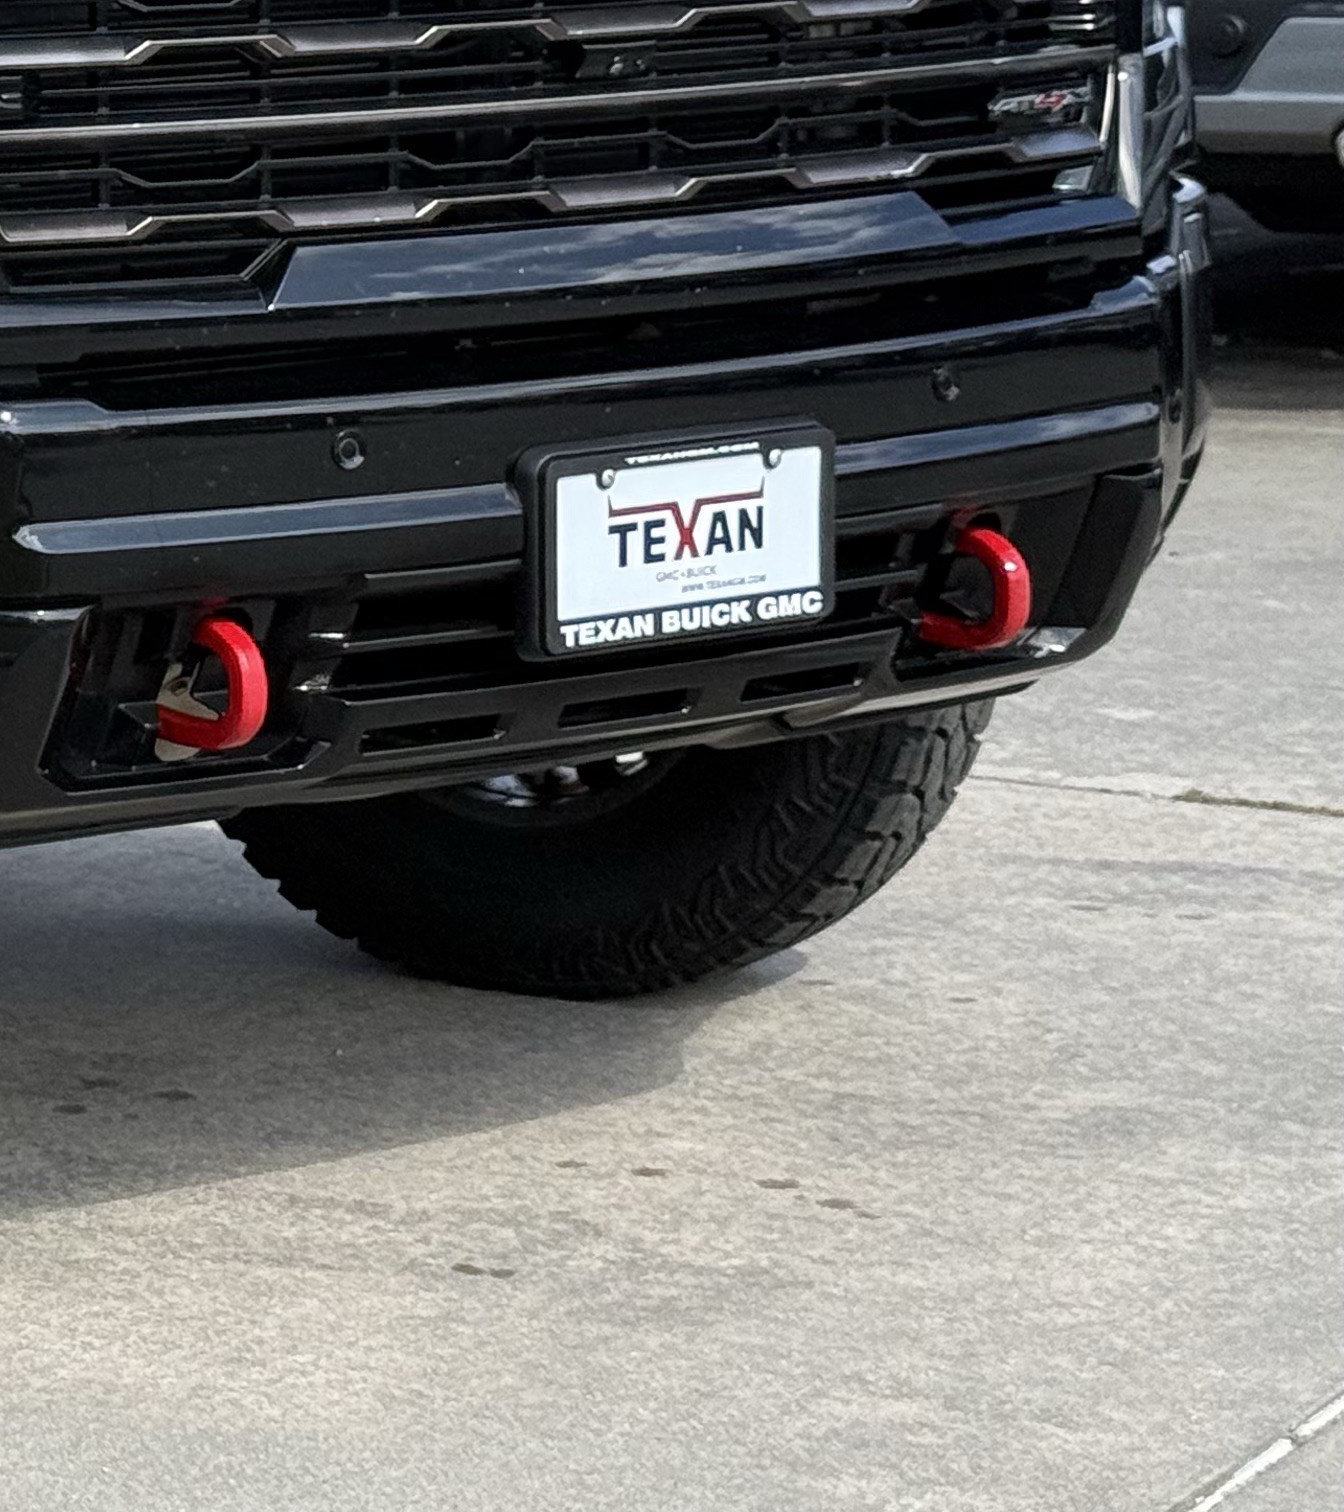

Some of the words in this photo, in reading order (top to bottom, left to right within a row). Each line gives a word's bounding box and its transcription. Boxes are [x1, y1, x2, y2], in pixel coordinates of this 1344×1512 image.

[608, 501, 764, 568] TEXAN
[560, 612, 655, 648] TEXAN
[661, 599, 752, 634] BUICK
[756, 589, 824, 620] GMC
